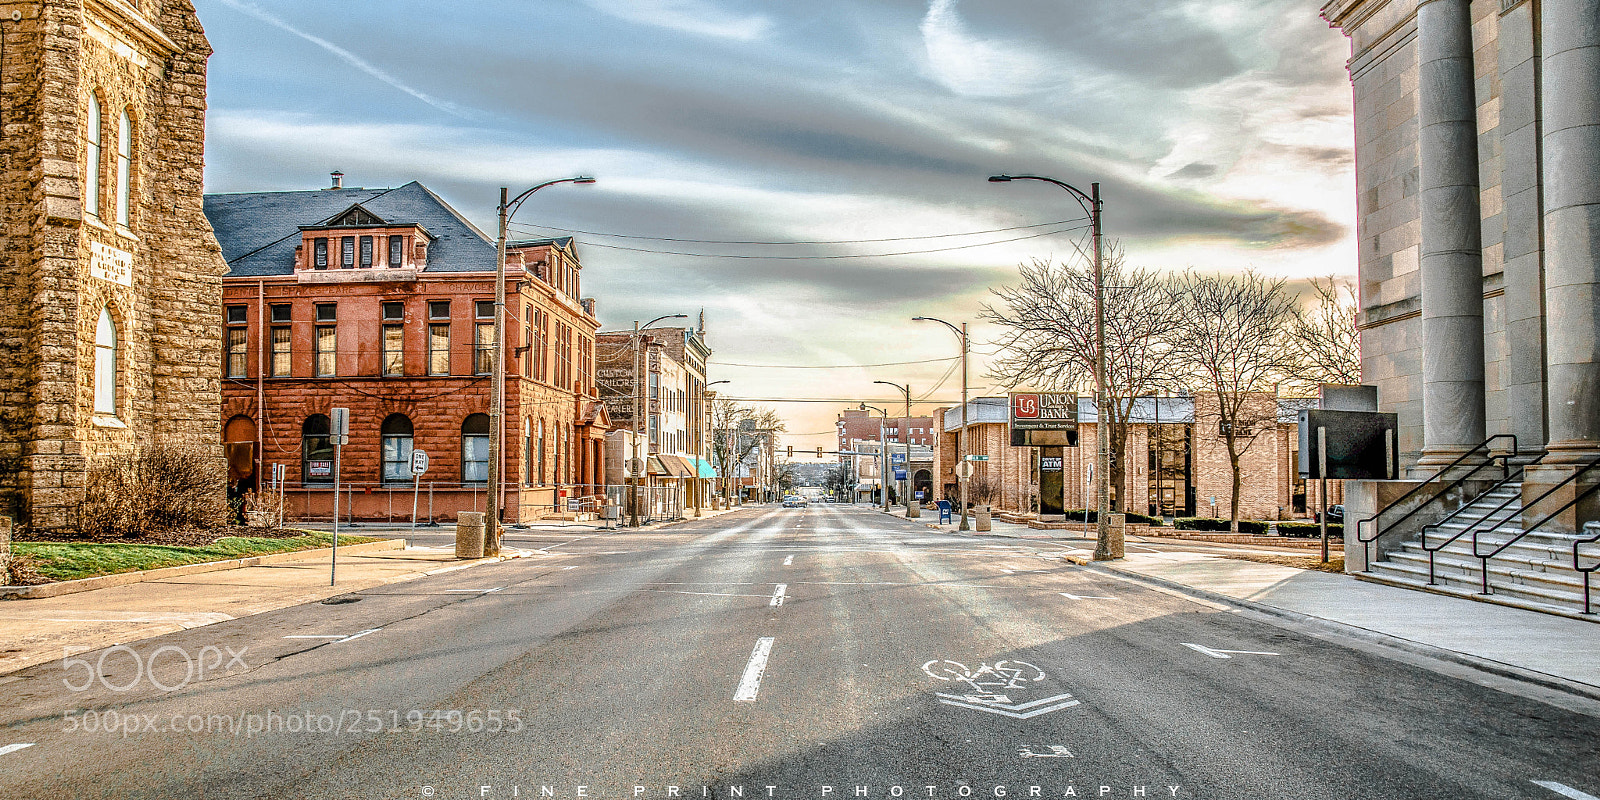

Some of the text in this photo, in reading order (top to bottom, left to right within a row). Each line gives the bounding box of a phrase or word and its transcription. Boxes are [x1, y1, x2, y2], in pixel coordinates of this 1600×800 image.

[601, 379, 635, 387] TAILORS
[1039, 393, 1075, 408] UNION
[1040, 408, 1069, 419] BANK
